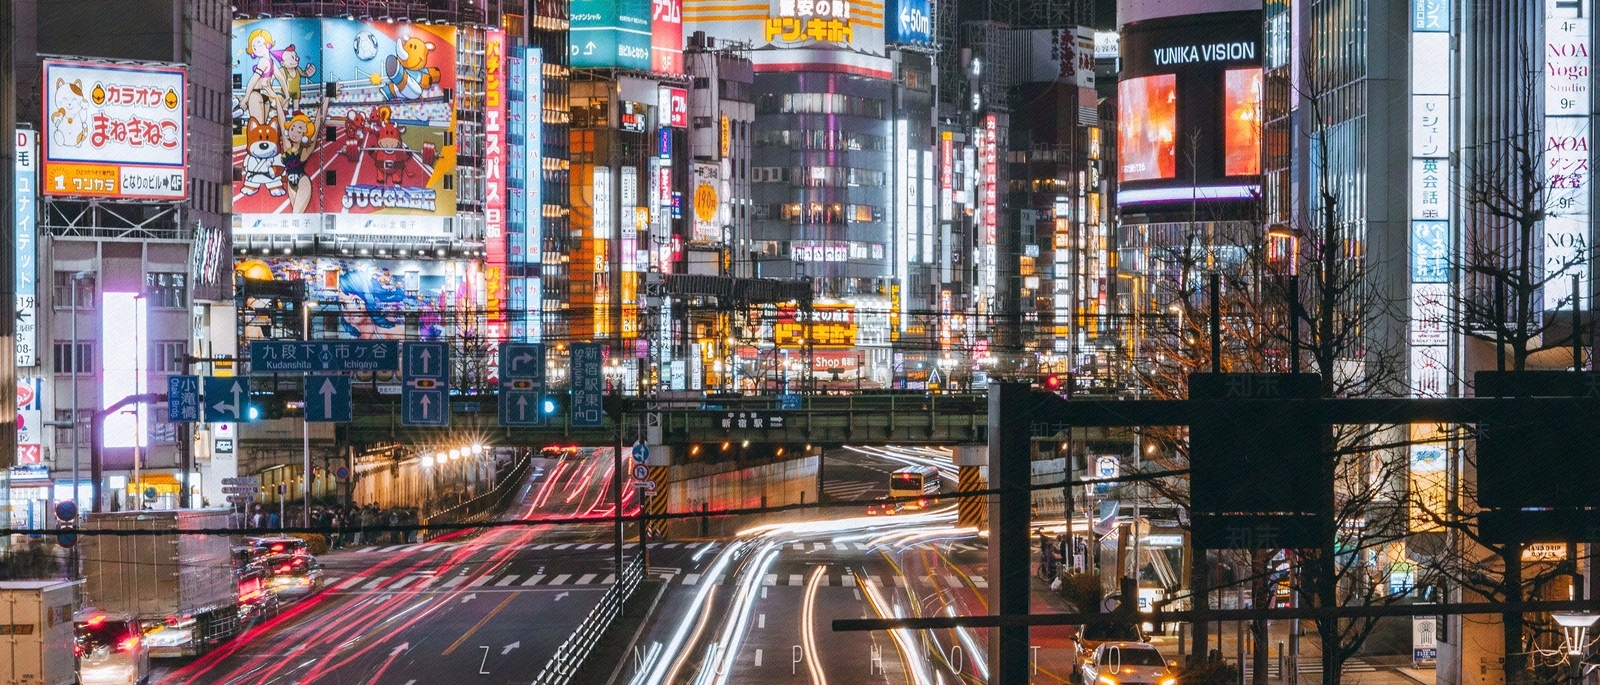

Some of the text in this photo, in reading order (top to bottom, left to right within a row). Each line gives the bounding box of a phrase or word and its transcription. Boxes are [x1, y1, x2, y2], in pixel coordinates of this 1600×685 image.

[652, 0, 681, 24] アコム
[911, 12, 930, 34] 50m
[1560, 21, 1576, 32] 4F
[1154, 41, 1255, 66] YUNIKA VISION
[1548, 43, 1588, 57] NOA
[487, 41, 500, 107] パチンコ
[1547, 62, 1588, 80] Yoga
[107, 86, 163, 106] カラオケ
[1550, 83, 1586, 92] Studio
[1560, 98, 1576, 109] 9F
[91, 113, 180, 149] まねきねこ
[1423, 116, 1438, 156] シェーン
[1547, 136, 1588, 152] NOA
[487, 111, 500, 203] エスパス
[1549, 158, 1588, 170] ダンス
[72, 178, 115, 192] ワンカラ
[122, 174, 182, 191] となりのビル 4F
[1423, 160, 1438, 204] 英会話
[1552, 174, 1582, 189] 教室
[342, 185, 436, 211] JUGGLER
[281, 219, 312, 229] 北電子
[18, 177, 32, 290] ユナイテッド
[1546, 233, 1587, 248] NOA
[1431, 223, 1445, 276] ベースボール
[18, 355, 30, 365] 47
[262, 344, 316, 359] 九段下
[266, 360, 312, 370] Kudanshita
[344, 360, 378, 371] Ichigaya
[574, 349, 584, 387] Shinjuku
[815, 356, 840, 368] Shop
[585, 347, 598, 421] 新宿駅東口
[181, 379, 197, 420] 小滝橋
